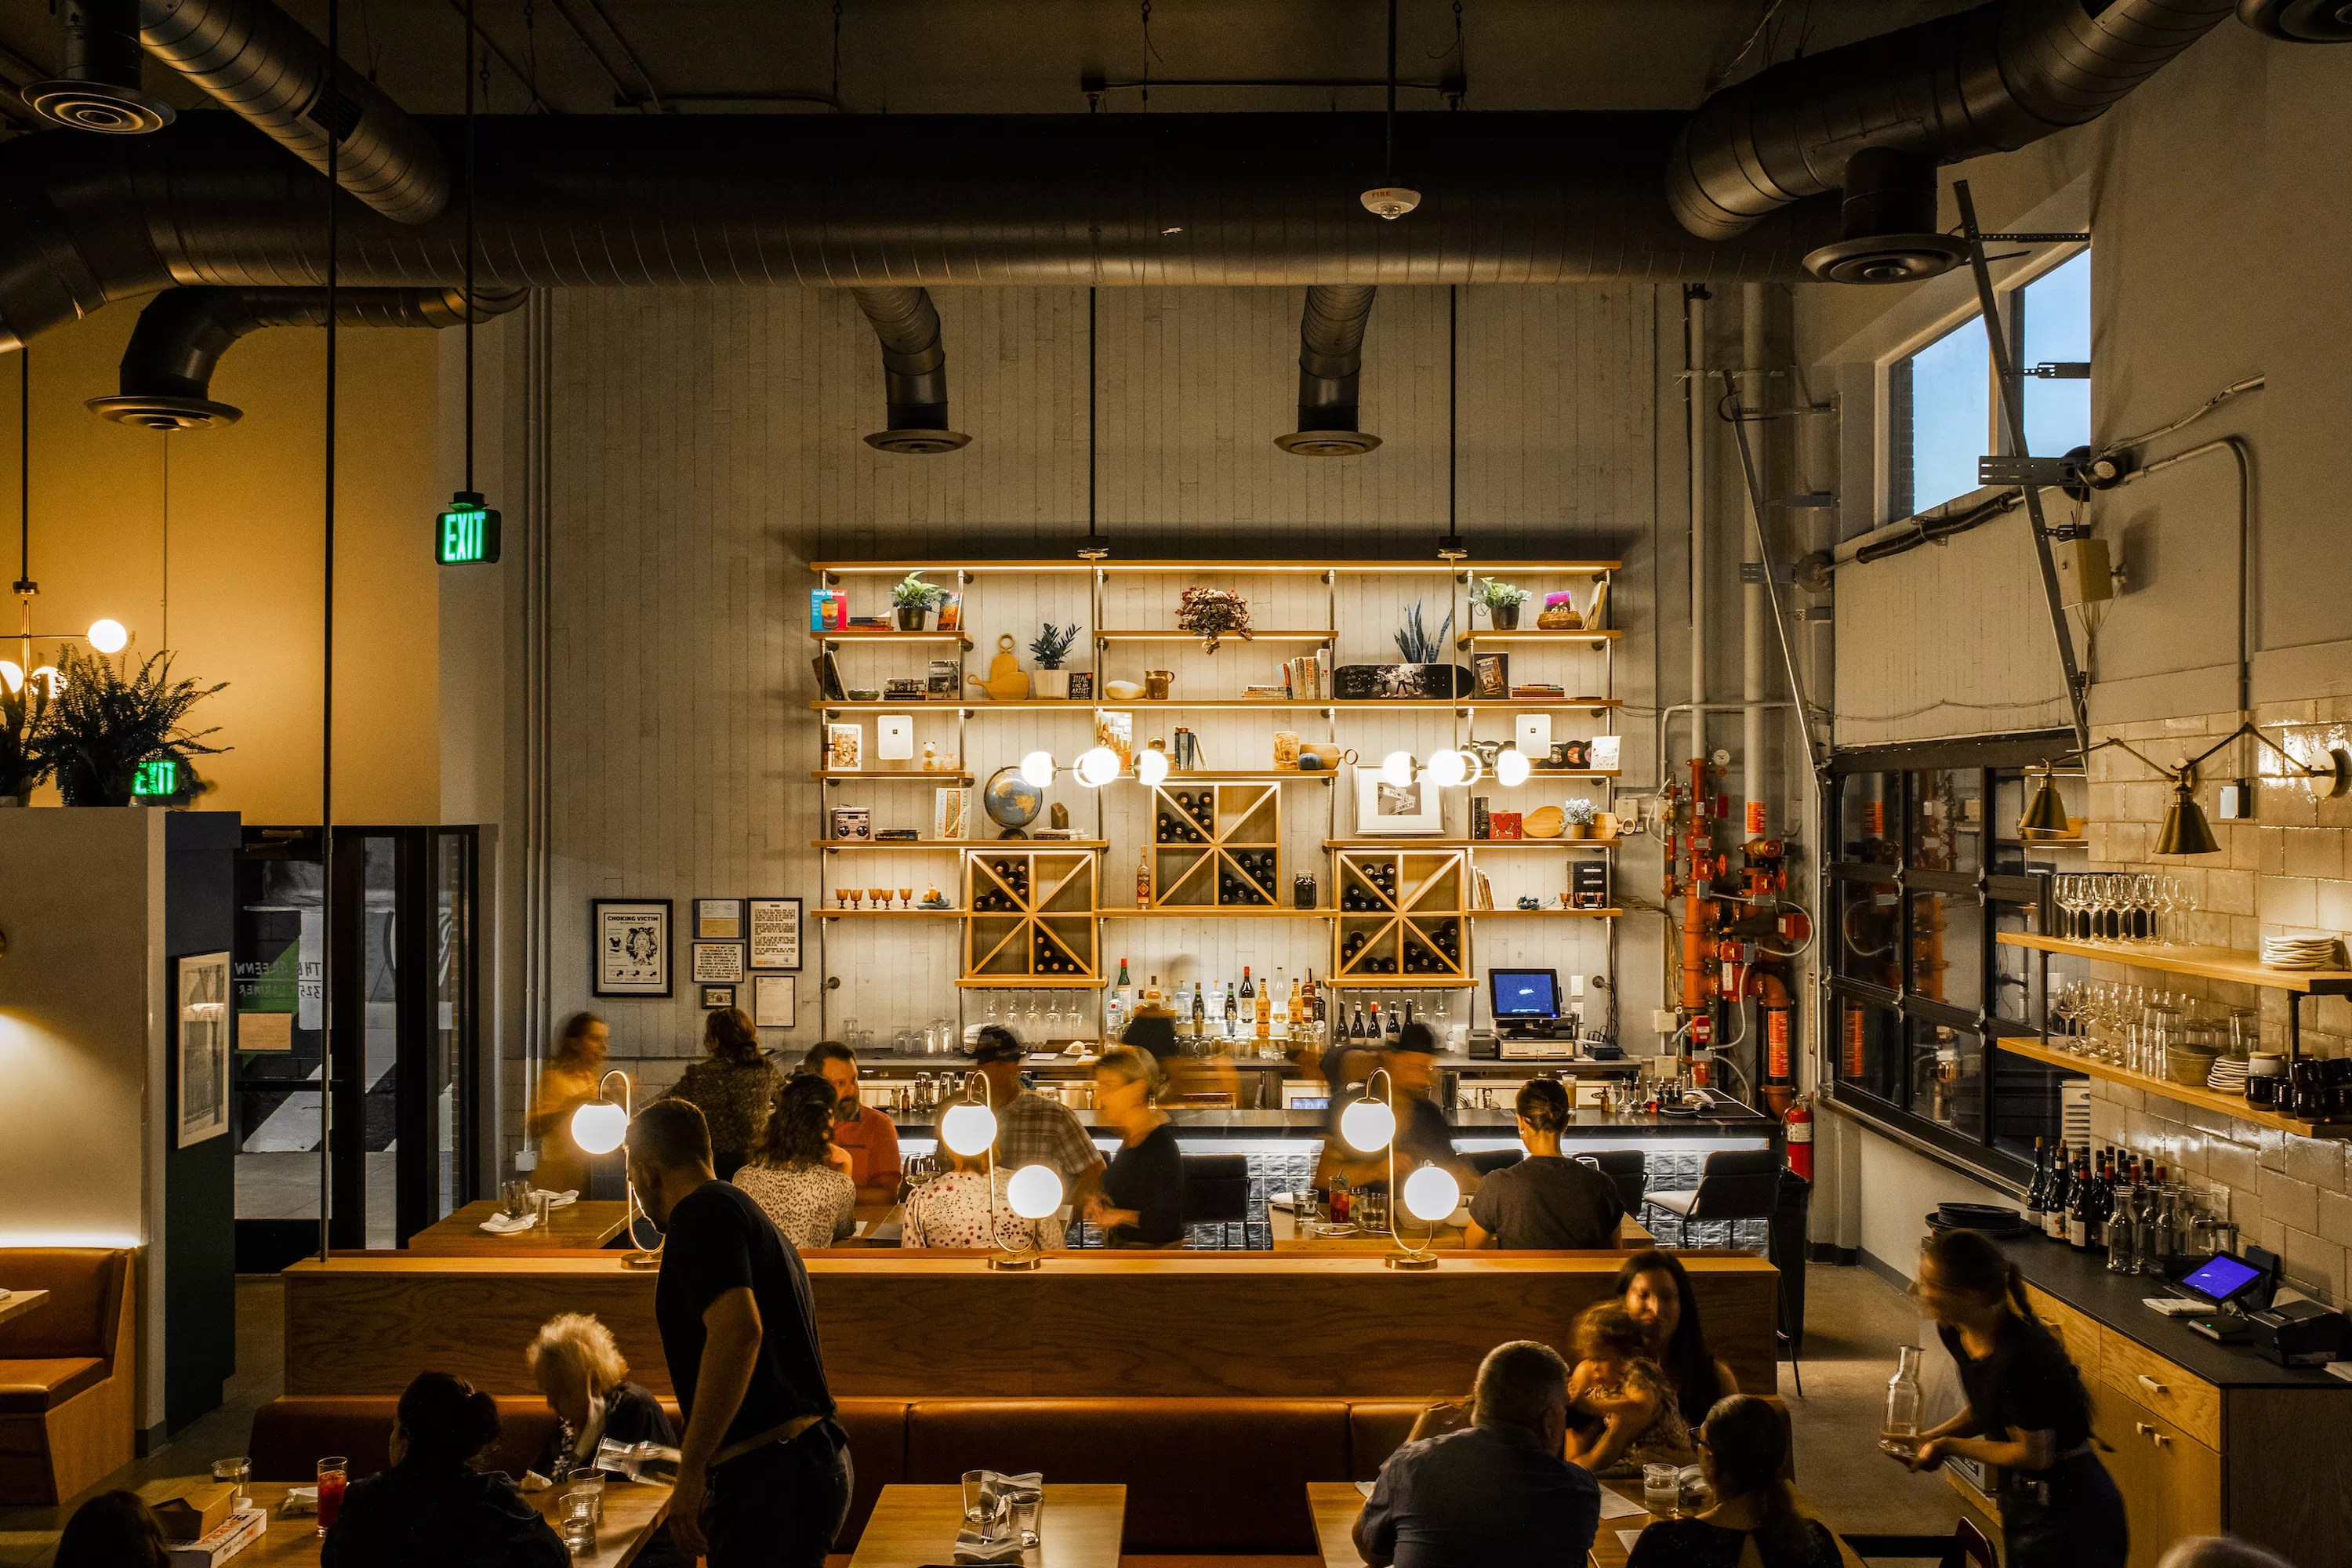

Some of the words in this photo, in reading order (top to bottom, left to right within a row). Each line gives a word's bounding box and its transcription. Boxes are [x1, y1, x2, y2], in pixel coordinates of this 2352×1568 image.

[444, 511, 486, 561] EXIT
[134, 761, 176, 795] EXIT
[1389, 789, 1410, 800] POWELL
